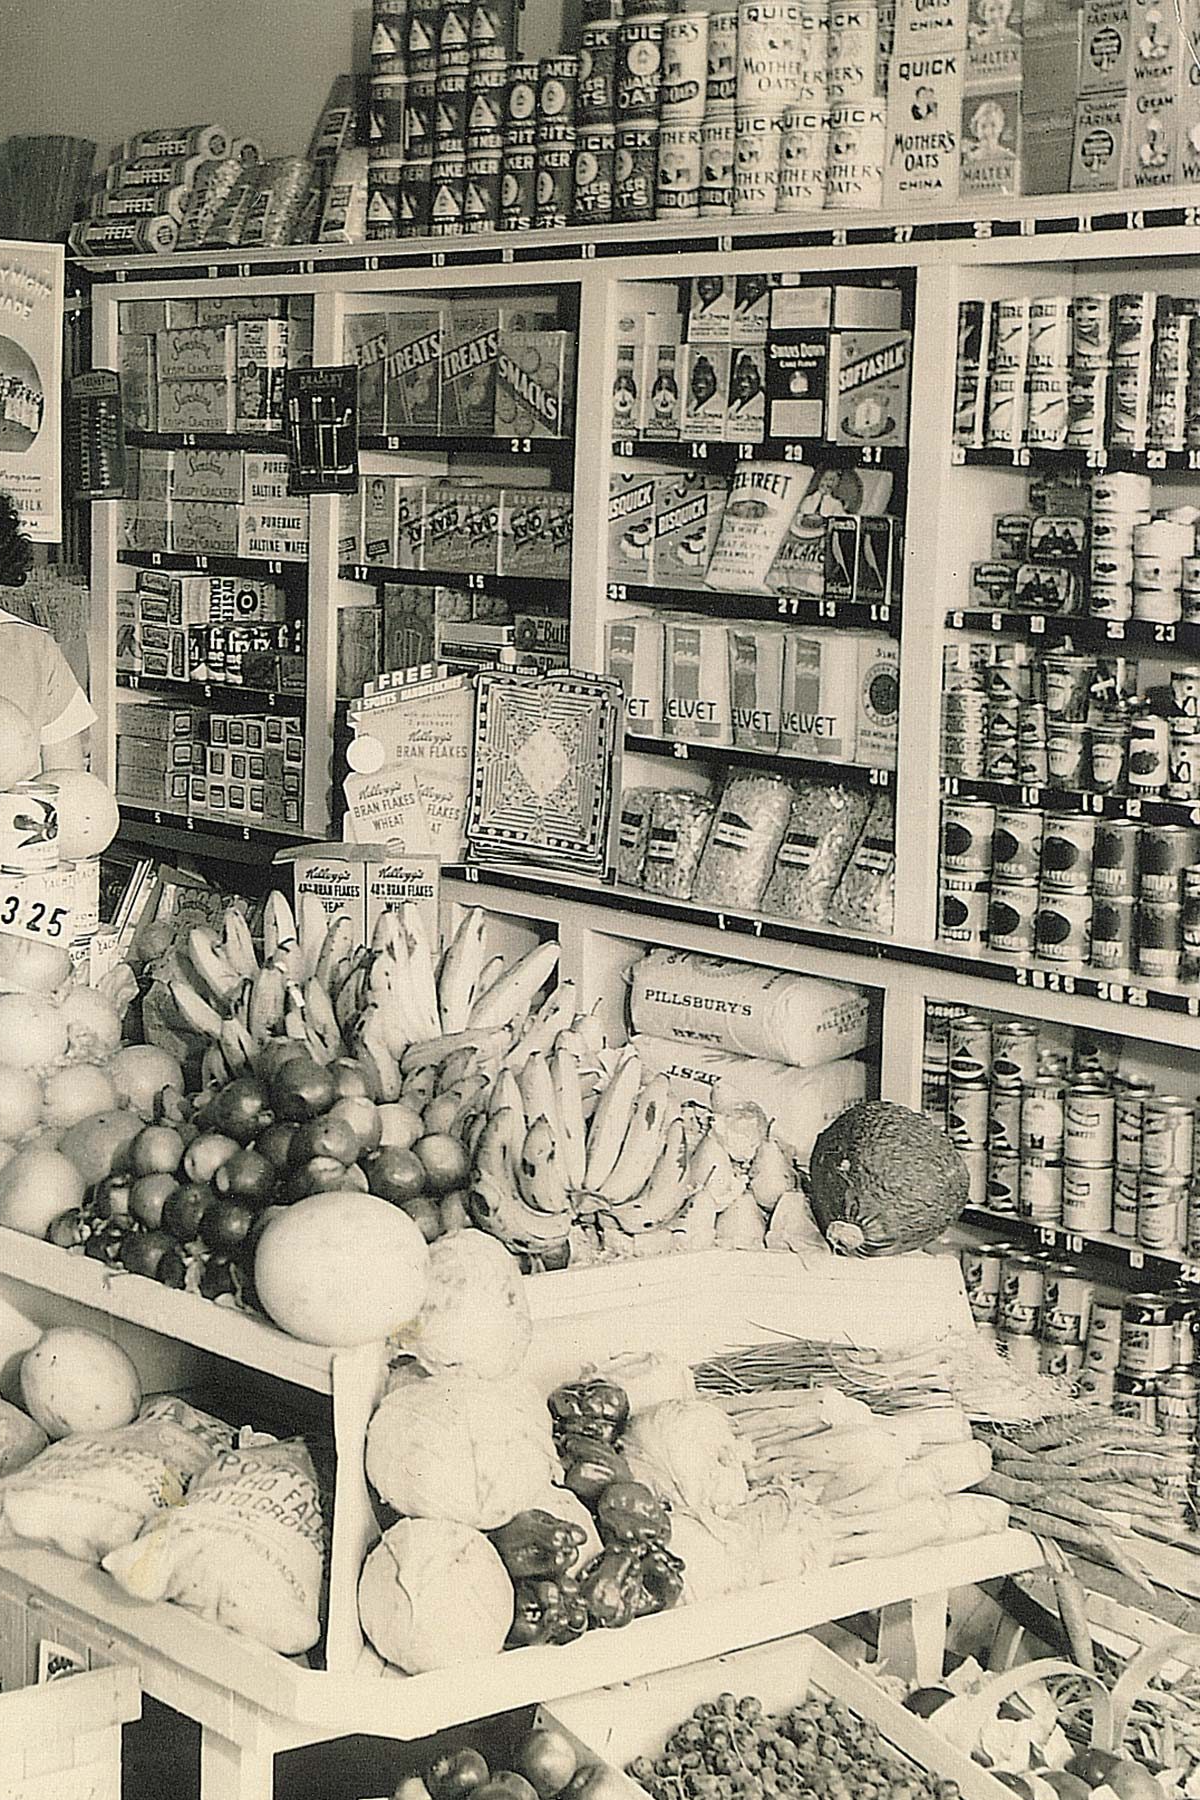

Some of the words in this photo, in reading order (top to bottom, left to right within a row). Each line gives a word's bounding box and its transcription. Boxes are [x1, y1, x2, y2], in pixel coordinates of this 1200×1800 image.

[900, 59, 956, 80] QUICK
[904, 154, 939, 171] OATS
[900, 180, 942, 190] CHINA
[355, 334, 387, 364] EATS
[390, 332, 442, 378] TREATS
[442, 332, 499, 383] TREATS
[499, 355, 557, 420] SNACKS
[511, 439, 531, 452] 23
[354, 567, 368, 580] 17
[778, 599, 798, 615] 27
[818, 601, 835, 618] 13
[870, 605, 889, 621] 10
[1155, 625, 1175, 641] 23
[378, 663, 433, 690] FREE
[205, 685, 211, 697] 5
[269, 694, 275, 705] 5
[781, 715, 837, 736] VELVET
[396, 746, 423, 759] BRAN
[430, 746, 468, 759] FLAKES
[870, 769, 888, 786] 30
[353, 800, 380, 818] BRAN
[381, 792, 416, 810] FLAKES
[426, 804, 459, 821] FLAKES
[155, 813, 161, 823] 5
[187, 818, 193, 829] 5
[372, 814, 404, 830] WHEAT
[244, 828, 249, 839] 5
[305, 867, 351, 882] Kellogg's
[378, 866, 424, 882] Kellogg's
[466, 867, 478, 881] 10
[334, 883, 360, 897] FLAKES
[407, 884, 433, 897] FLAKES
[1, 896, 20, 924] 3
[26, 902, 67, 937] 25
[644, 989, 752, 1017] PILLSBURY'S
